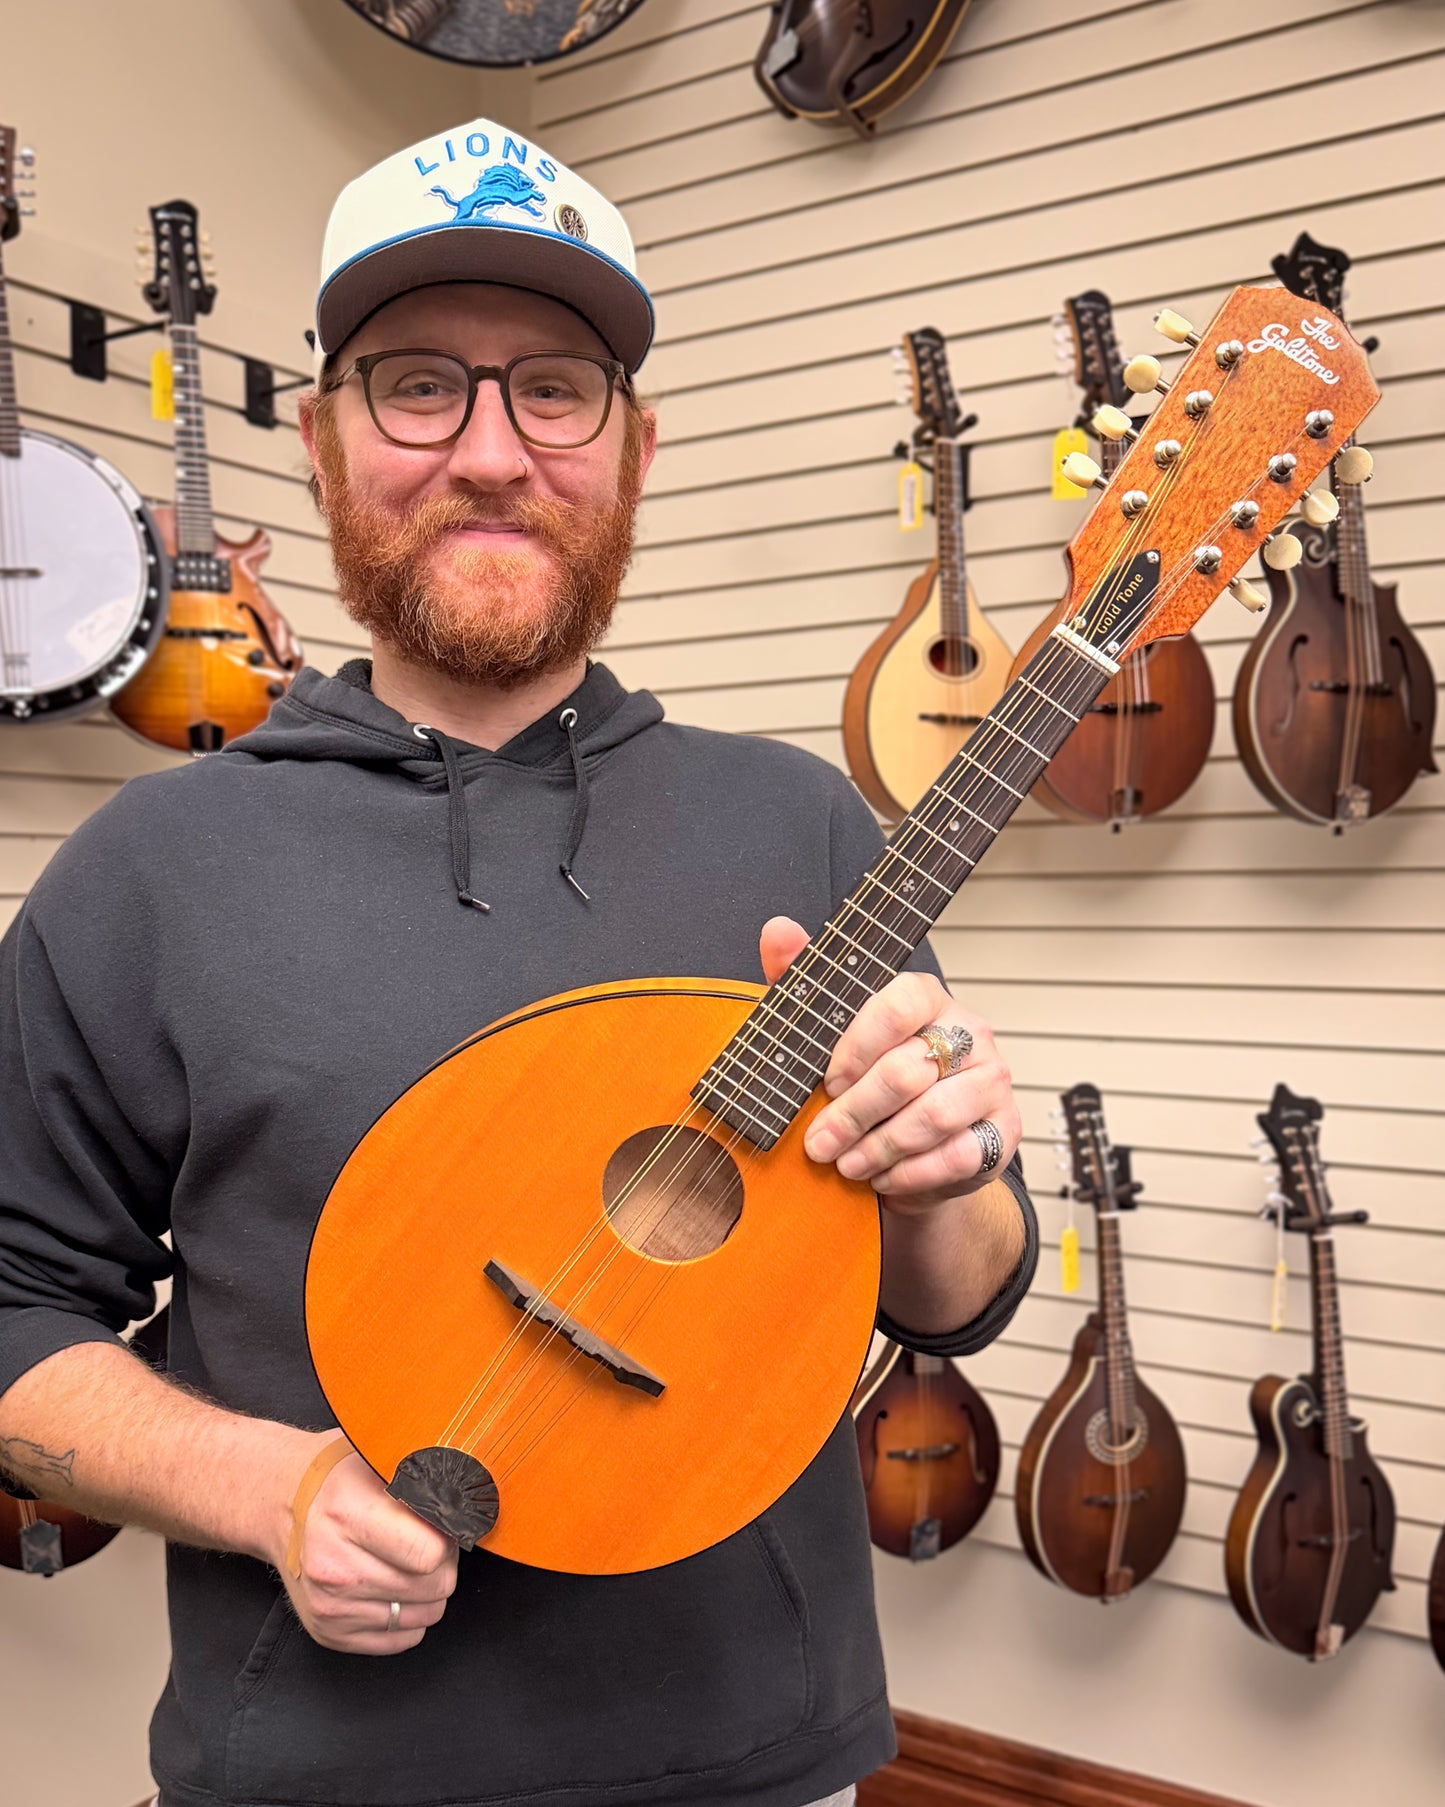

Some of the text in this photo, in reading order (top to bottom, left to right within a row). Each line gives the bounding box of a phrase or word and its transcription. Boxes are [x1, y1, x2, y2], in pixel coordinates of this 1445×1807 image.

[414, 132, 558, 183] LIONS
[1246, 323, 1340, 385] Goldtone
[1300, 316, 1340, 350] The
[1097, 573, 1144, 634] Gold Tone
